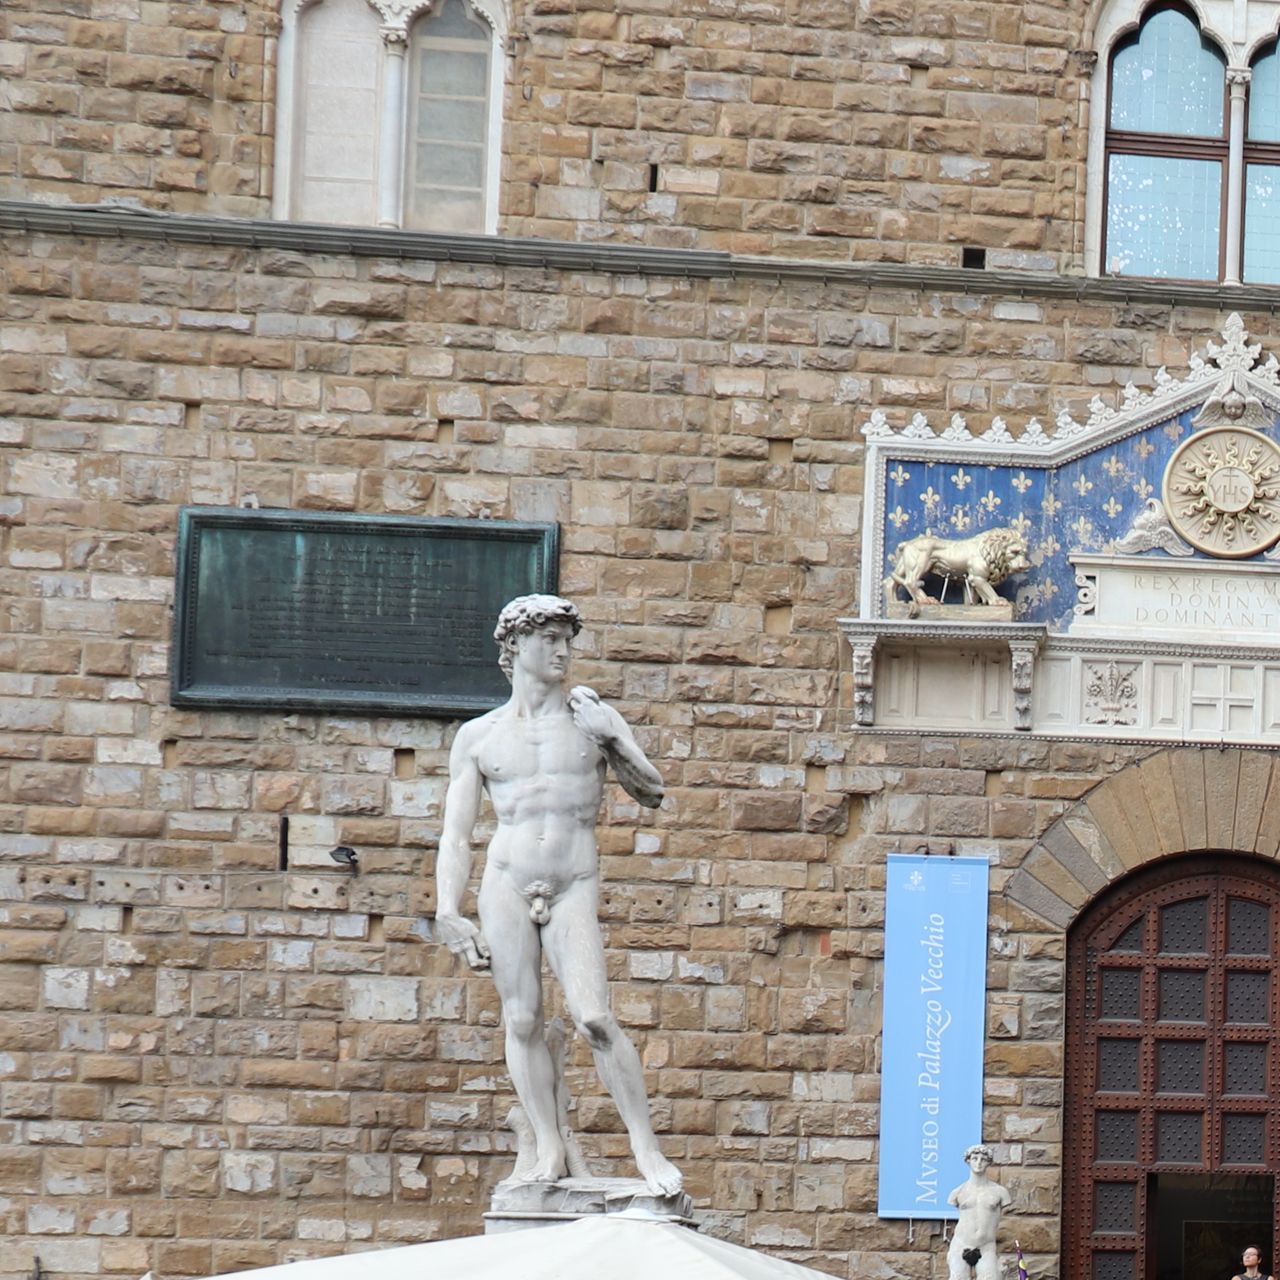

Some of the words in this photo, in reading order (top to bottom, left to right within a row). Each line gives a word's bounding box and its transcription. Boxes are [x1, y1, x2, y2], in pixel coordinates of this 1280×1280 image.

[1134, 574, 1181, 591] REX
[1193, 577, 1278, 596] REGVM
[920, 912, 945, 994] Vecchio
[917, 999, 952, 1090] Palazzo
[921, 1096, 940, 1117] di
